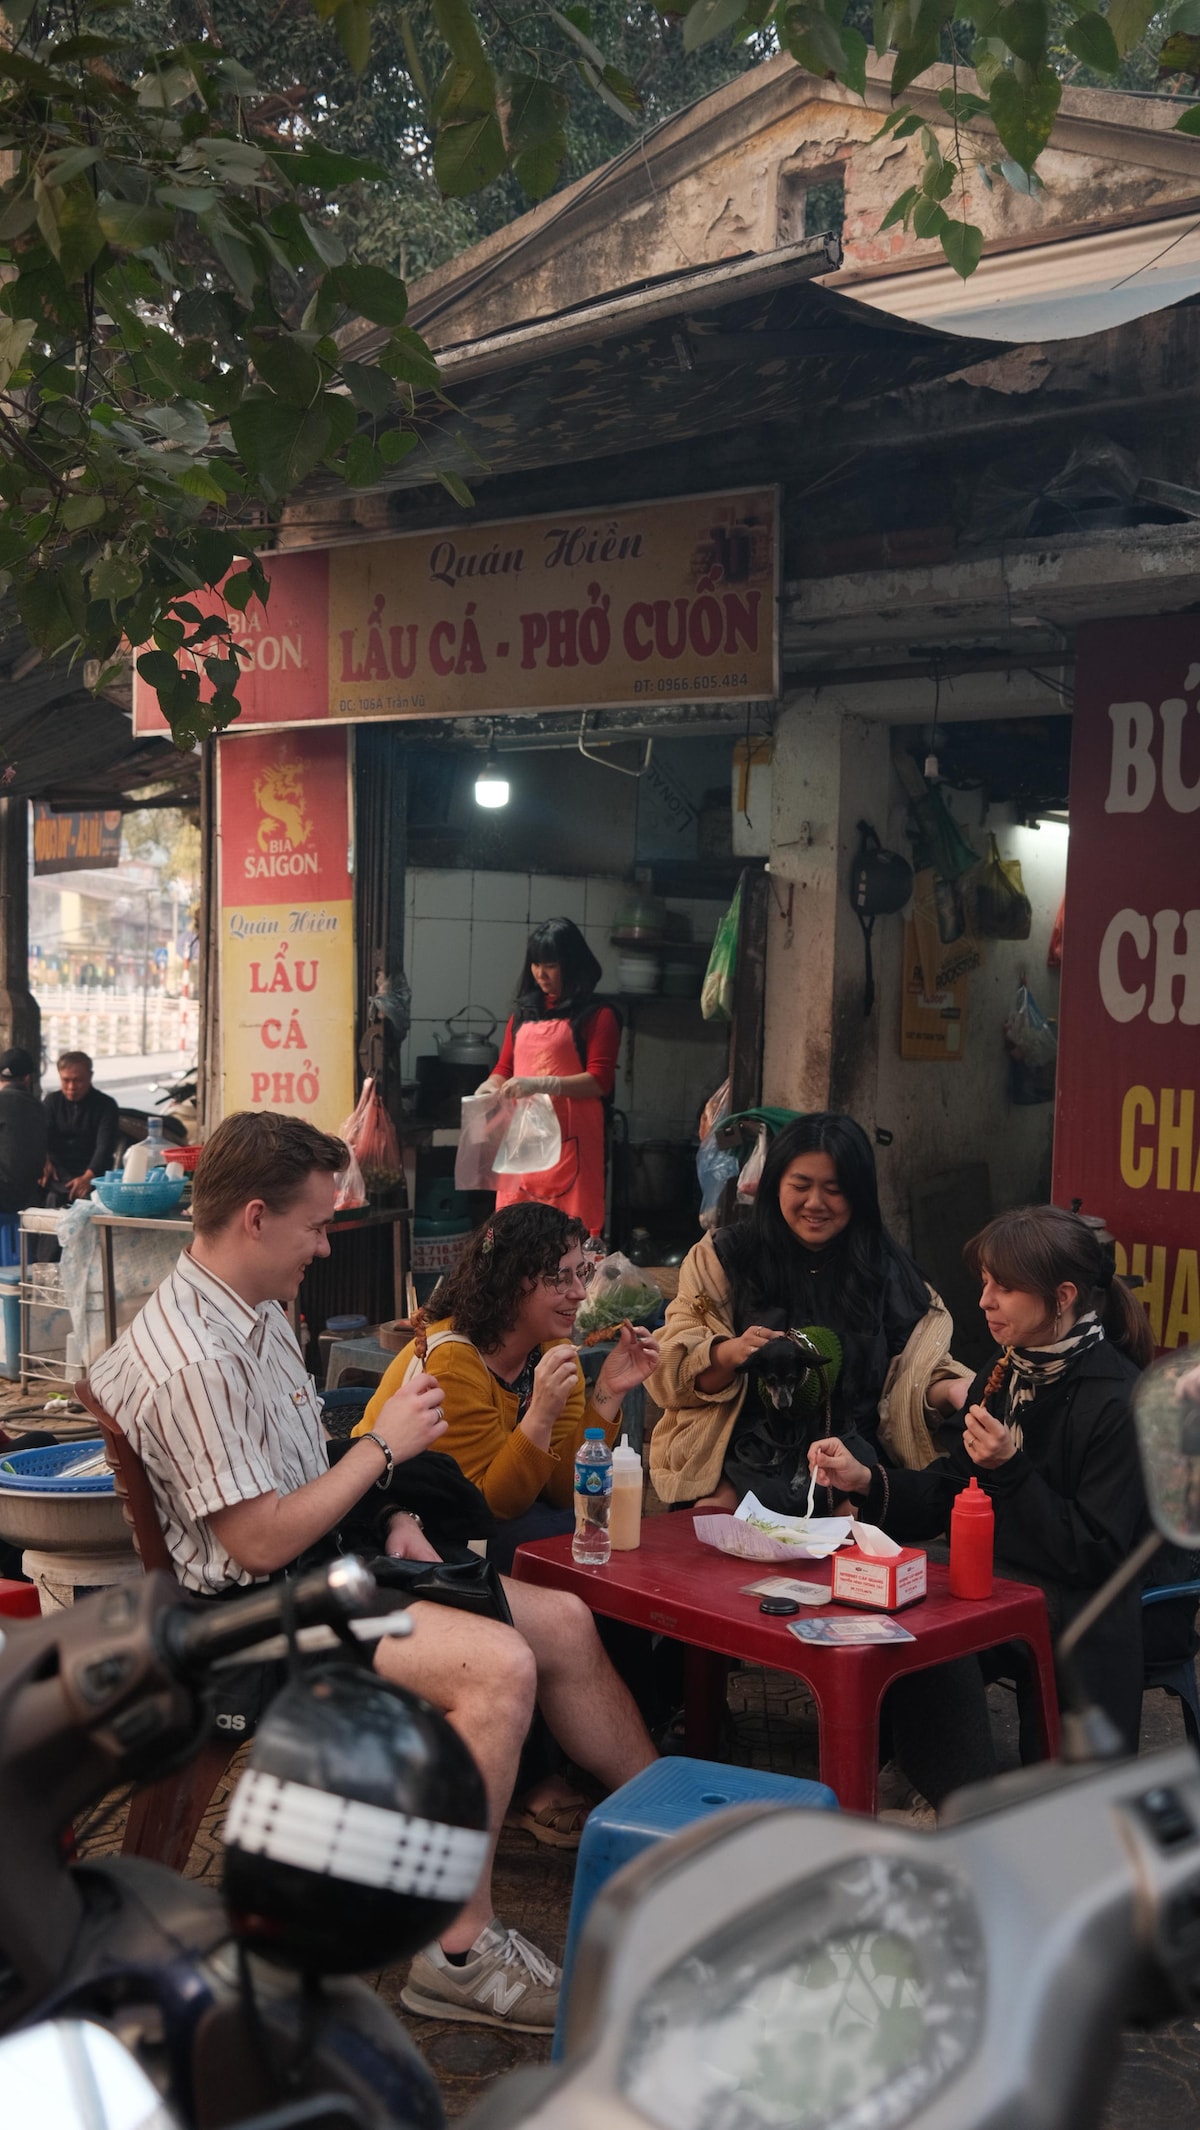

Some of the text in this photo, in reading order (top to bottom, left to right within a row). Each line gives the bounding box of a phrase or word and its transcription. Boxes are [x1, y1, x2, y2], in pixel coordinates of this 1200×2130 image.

[429, 521, 643, 588] Quán Hiền
[228, 612, 262, 633] BIA
[339, 593, 419, 683] LẨU
[428, 601, 487, 677] CÁ
[519, 581, 611, 670] PHỞ
[623, 564, 762, 662] CUỐN
[634, 672, 748, 693] ĐT: 0966.605.484
[359, 697, 383, 711] 106A
[244, 852, 318, 879] SAIGON
[269, 839, 293, 854] BIA
[229, 910, 339, 939] Quán Hiền
[249, 941, 319, 994] LẨU
[261, 1008, 308, 1050] CÁ
[251, 1059, 320, 1105] PHỞ
[1120, 1084, 1200, 1192] CH
[474, 1970, 527, 2015] N
